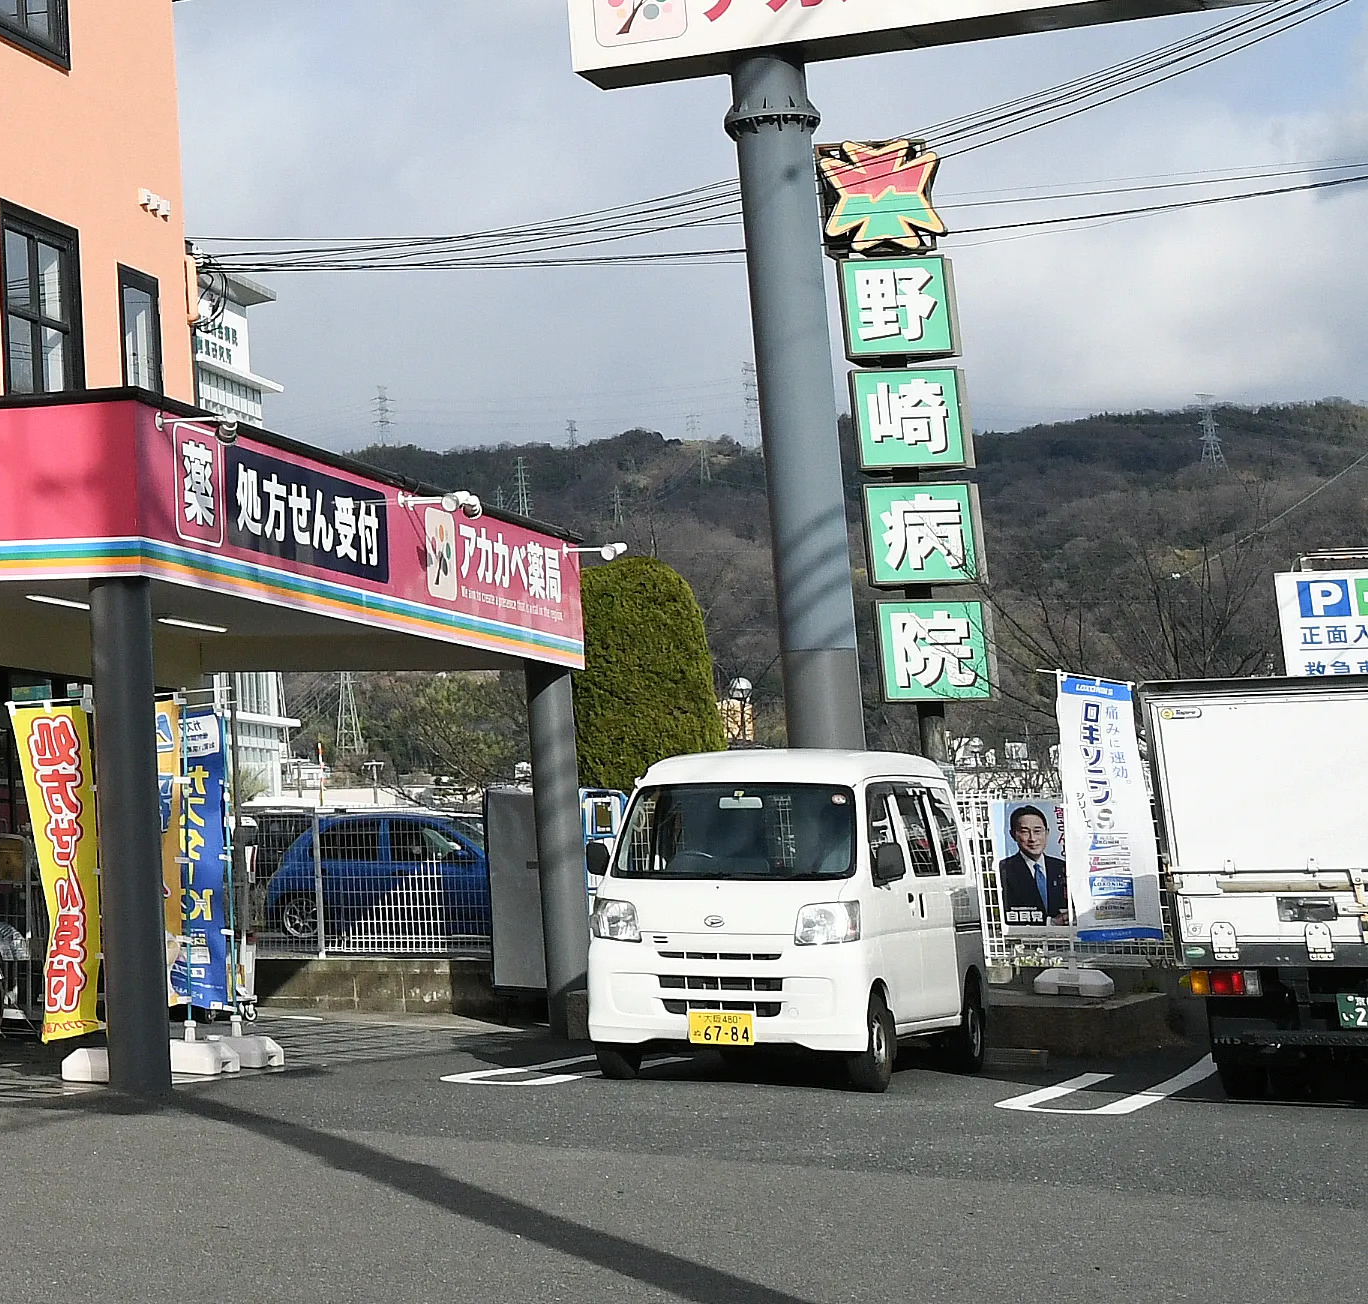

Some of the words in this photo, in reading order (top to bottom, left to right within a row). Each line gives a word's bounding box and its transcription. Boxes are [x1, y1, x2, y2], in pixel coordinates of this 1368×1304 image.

[181, 439, 215, 527] 薬
[235, 461, 380, 568] 処方せん受付
[857, 266, 977, 690] 野崎病院
[459, 523, 562, 603] アカカベ薬局
[1309, 582, 1343, 616] P
[1083, 702, 1111, 804] ロキソニン
[704, 1026, 750, 1043] 67-84
